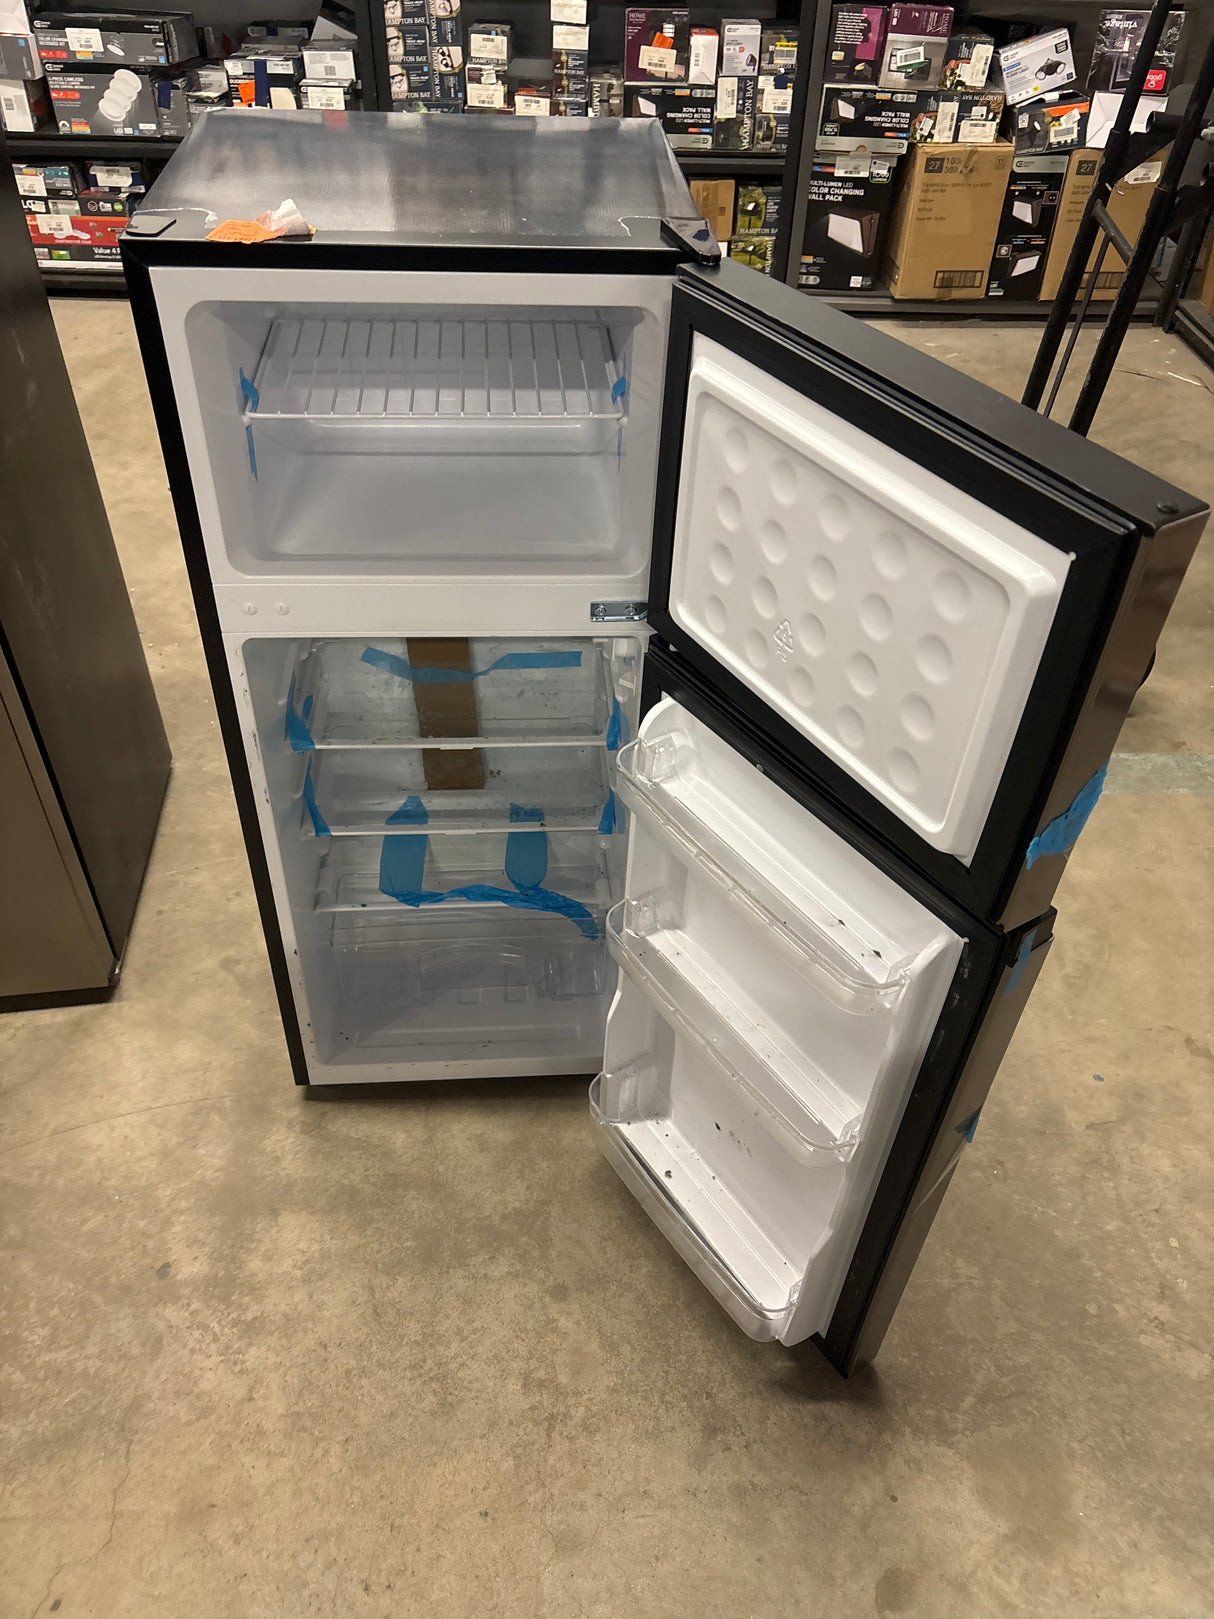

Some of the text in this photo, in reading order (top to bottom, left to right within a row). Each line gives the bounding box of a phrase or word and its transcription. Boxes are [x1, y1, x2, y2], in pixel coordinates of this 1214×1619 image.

[1103, 18, 1138, 29] vintage
[742, 80, 754, 146] HAMPTON BAY
[928, 161, 941, 170] 27
[1080, 163, 1093, 172] 27
[830, 187, 865, 196] CHANGING
[824, 194, 843, 202] PACK
